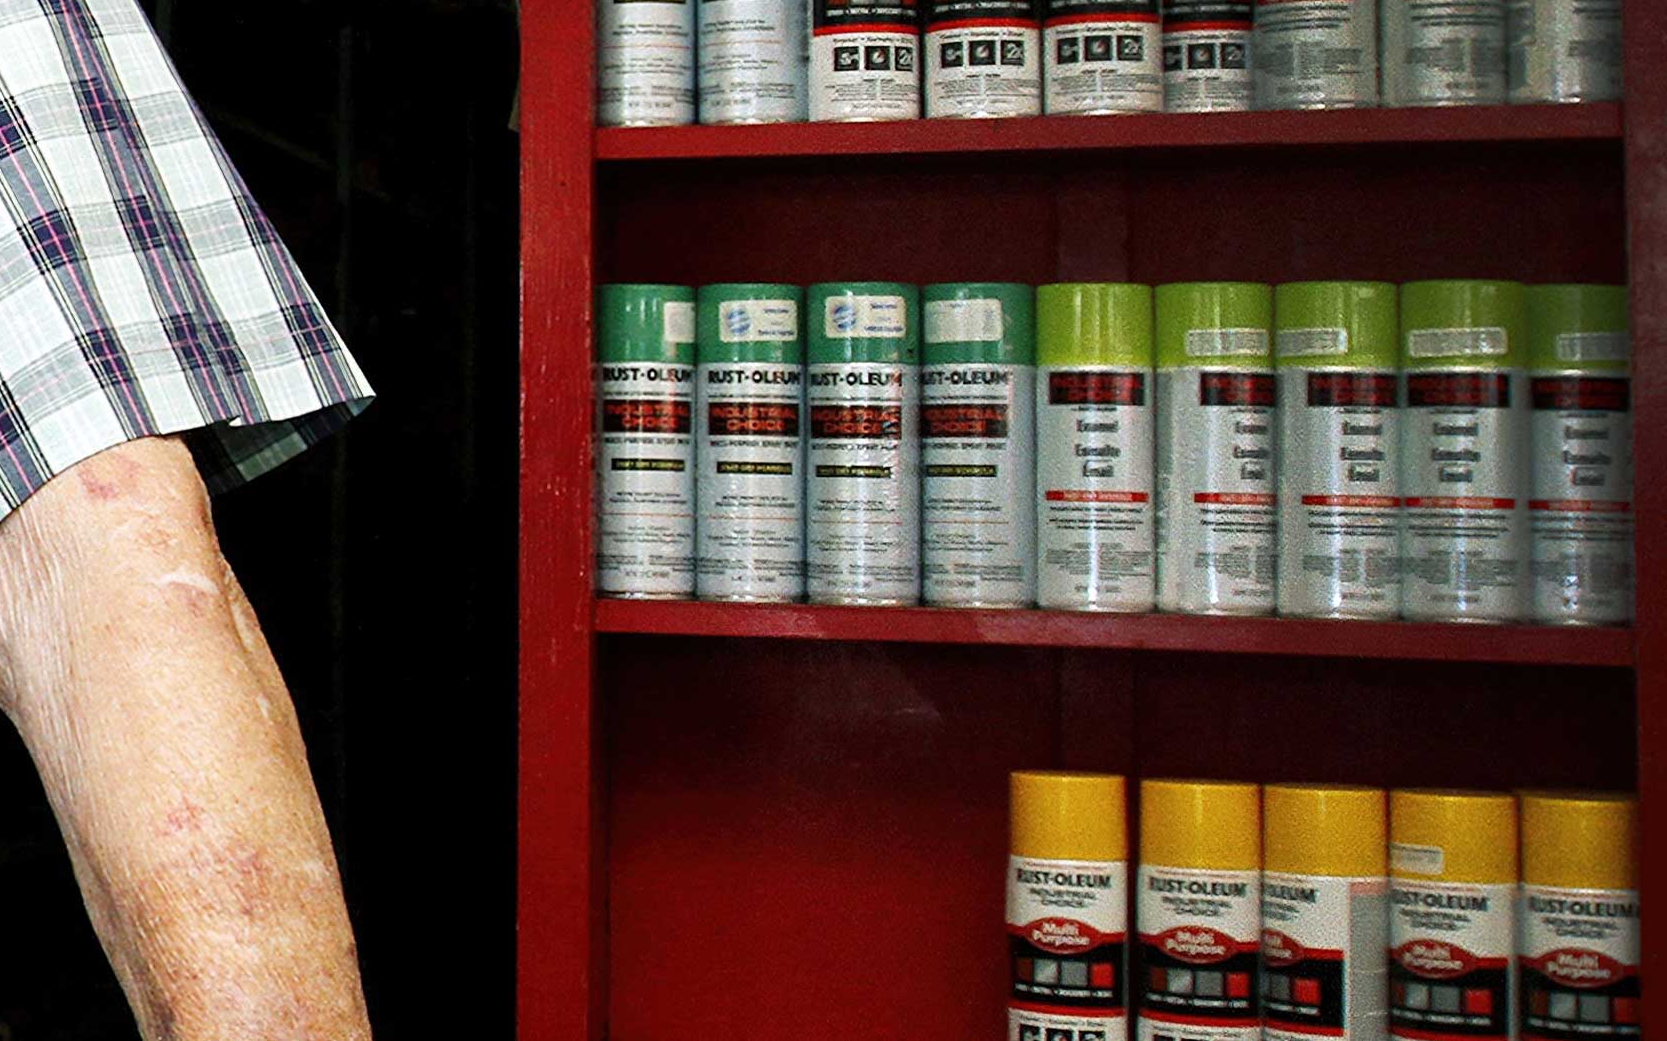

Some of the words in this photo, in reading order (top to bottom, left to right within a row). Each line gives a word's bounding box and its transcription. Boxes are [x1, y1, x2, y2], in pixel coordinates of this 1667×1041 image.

[602, 367, 692, 383] RUST-OLEUM
[708, 370, 802, 385] RUST-OLEUM
[1017, 868, 1112, 889] RUST-OLEUM
[1148, 876, 1247, 898] RUST-OLEUM
[1528, 897, 1639, 918] RUST-OLEUM
